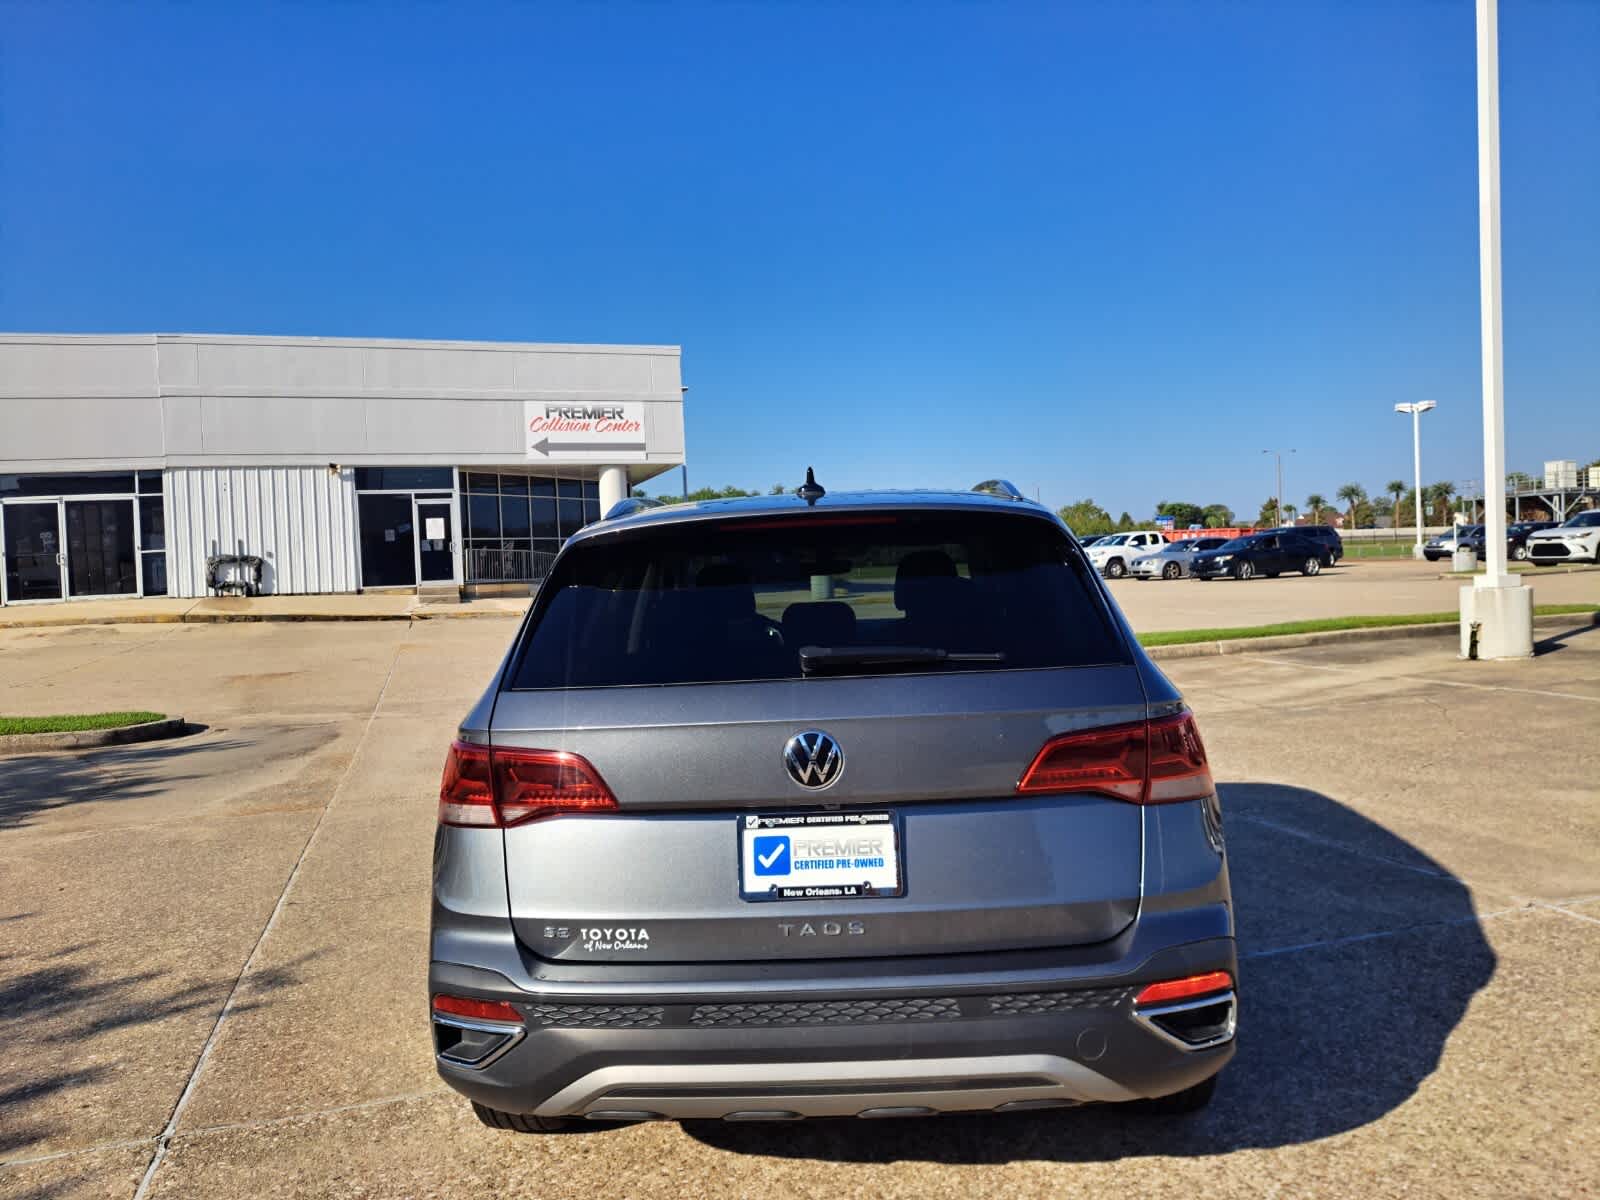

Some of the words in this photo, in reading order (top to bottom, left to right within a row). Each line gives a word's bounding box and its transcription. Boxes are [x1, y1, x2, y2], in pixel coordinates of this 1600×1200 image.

[544, 405, 624, 419] PREMIER
[529, 416, 591, 432] Collision
[594, 416, 641, 432] Center
[794, 839, 884, 857] PREMIER
[794, 859, 834, 871] CERTIFIED
[836, 857, 884, 869] PRE-OWNED
[783, 888, 803, 897] New
[844, 886, 857, 895] LA
[580, 928, 649, 940] TOYOTA
[778, 920, 865, 937] TAOS
[583, 940, 594, 952] of
[595, 940, 612, 950] New
[613, 940, 648, 950] Orleans
